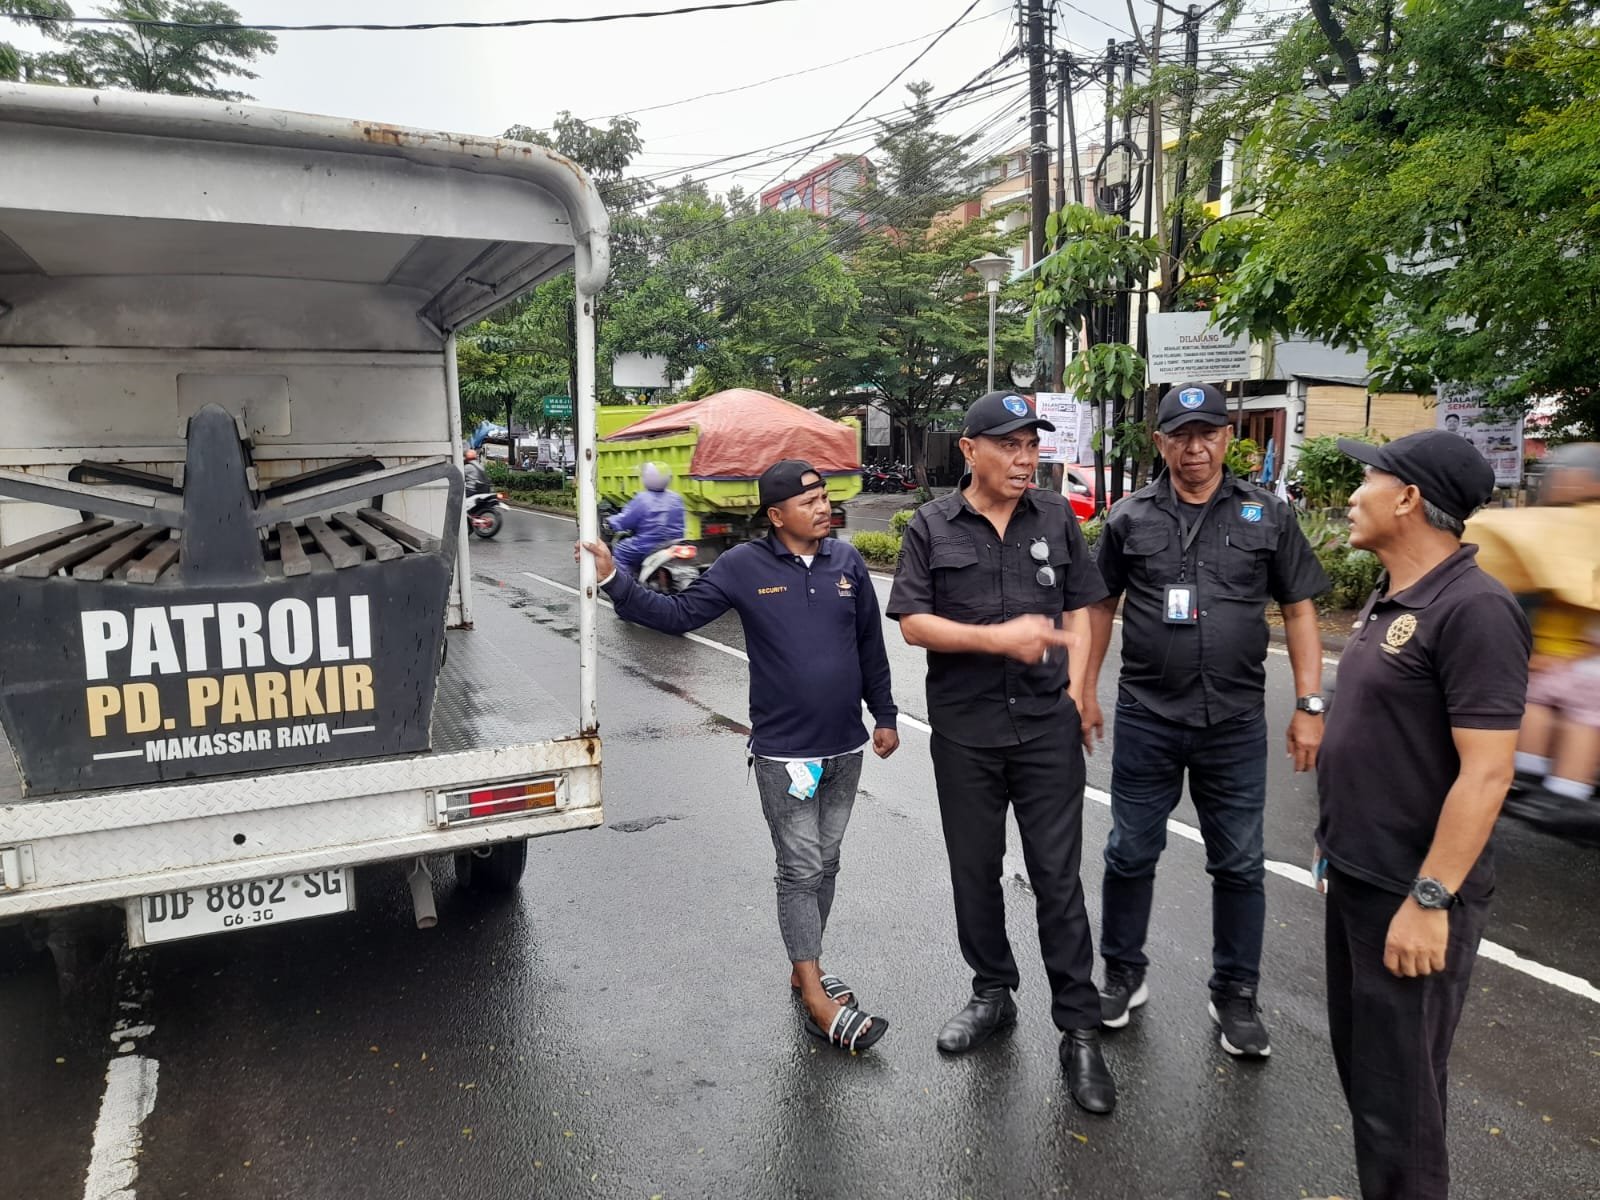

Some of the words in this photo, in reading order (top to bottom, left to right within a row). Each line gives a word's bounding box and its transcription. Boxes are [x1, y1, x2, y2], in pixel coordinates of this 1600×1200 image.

[757, 586, 788, 595] SECURITY
[81, 594, 372, 681] PATROLI
[86, 683, 176, 738] PD.
[187, 664, 376, 727] PARKIR
[145, 728, 273, 762] MAKASSAR
[276, 722, 331, 748] RAYA
[206, 877, 286, 912] 8862
[303, 870, 342, 898] SG
